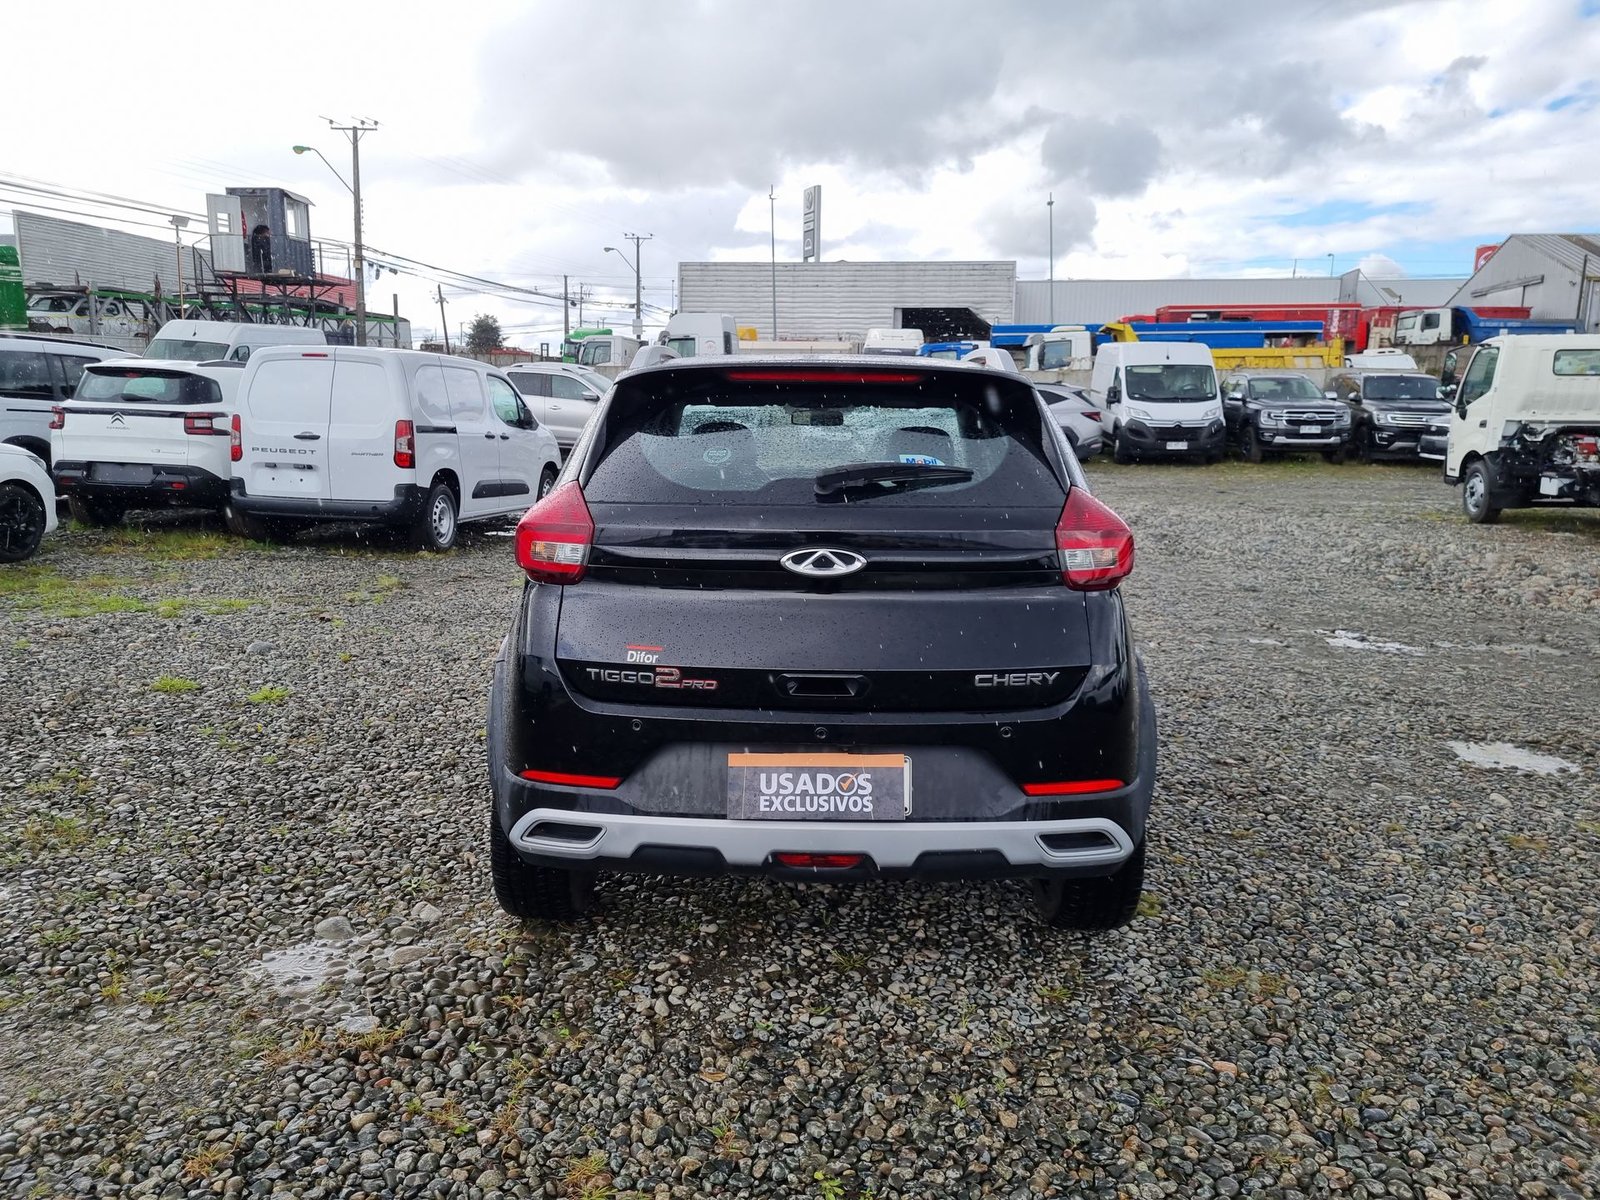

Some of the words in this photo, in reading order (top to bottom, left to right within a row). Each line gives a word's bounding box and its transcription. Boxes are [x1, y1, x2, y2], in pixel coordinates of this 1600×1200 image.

[251, 446, 317, 455] PEUGEOT
[906, 457, 938, 465] Mobil
[626, 650, 660, 664] Difor
[974, 671, 1061, 687] CHERY
[759, 772, 874, 797] USADOS
[759, 796, 874, 812] EXCLUSIVOS
